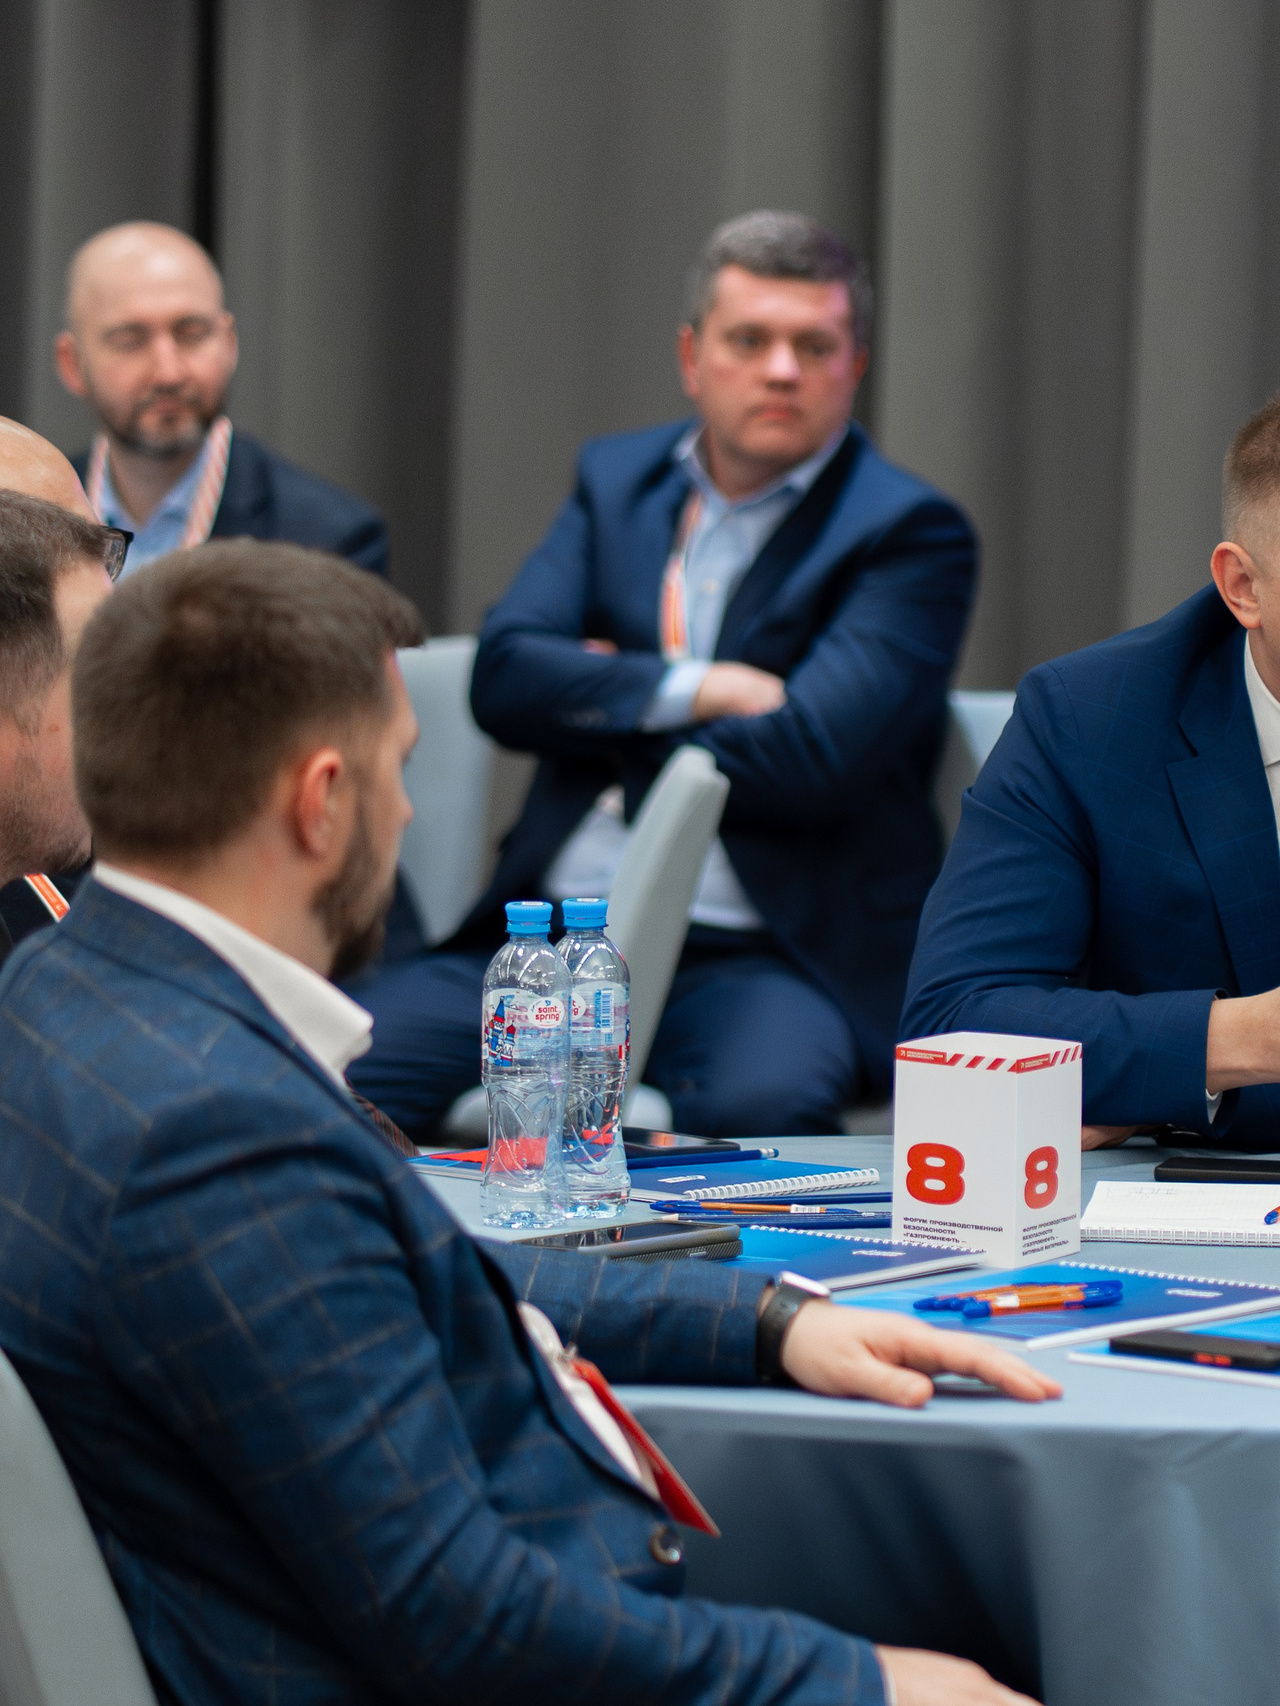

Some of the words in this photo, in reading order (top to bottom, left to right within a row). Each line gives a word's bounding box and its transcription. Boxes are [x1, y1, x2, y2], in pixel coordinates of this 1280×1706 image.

[538, 1005, 557, 1013] saint
[535, 1013, 559, 1021] spring
[906, 1142, 965, 1205] 8
[1024, 1145, 1059, 1209] 8
[903, 1216, 927, 1224] ФОРУМ
[929, 1219, 1003, 1232] ПРОИЗВОДСТВЕННОЙ
[903, 1224, 956, 1235] БЕЗОПАСНОСТИ
